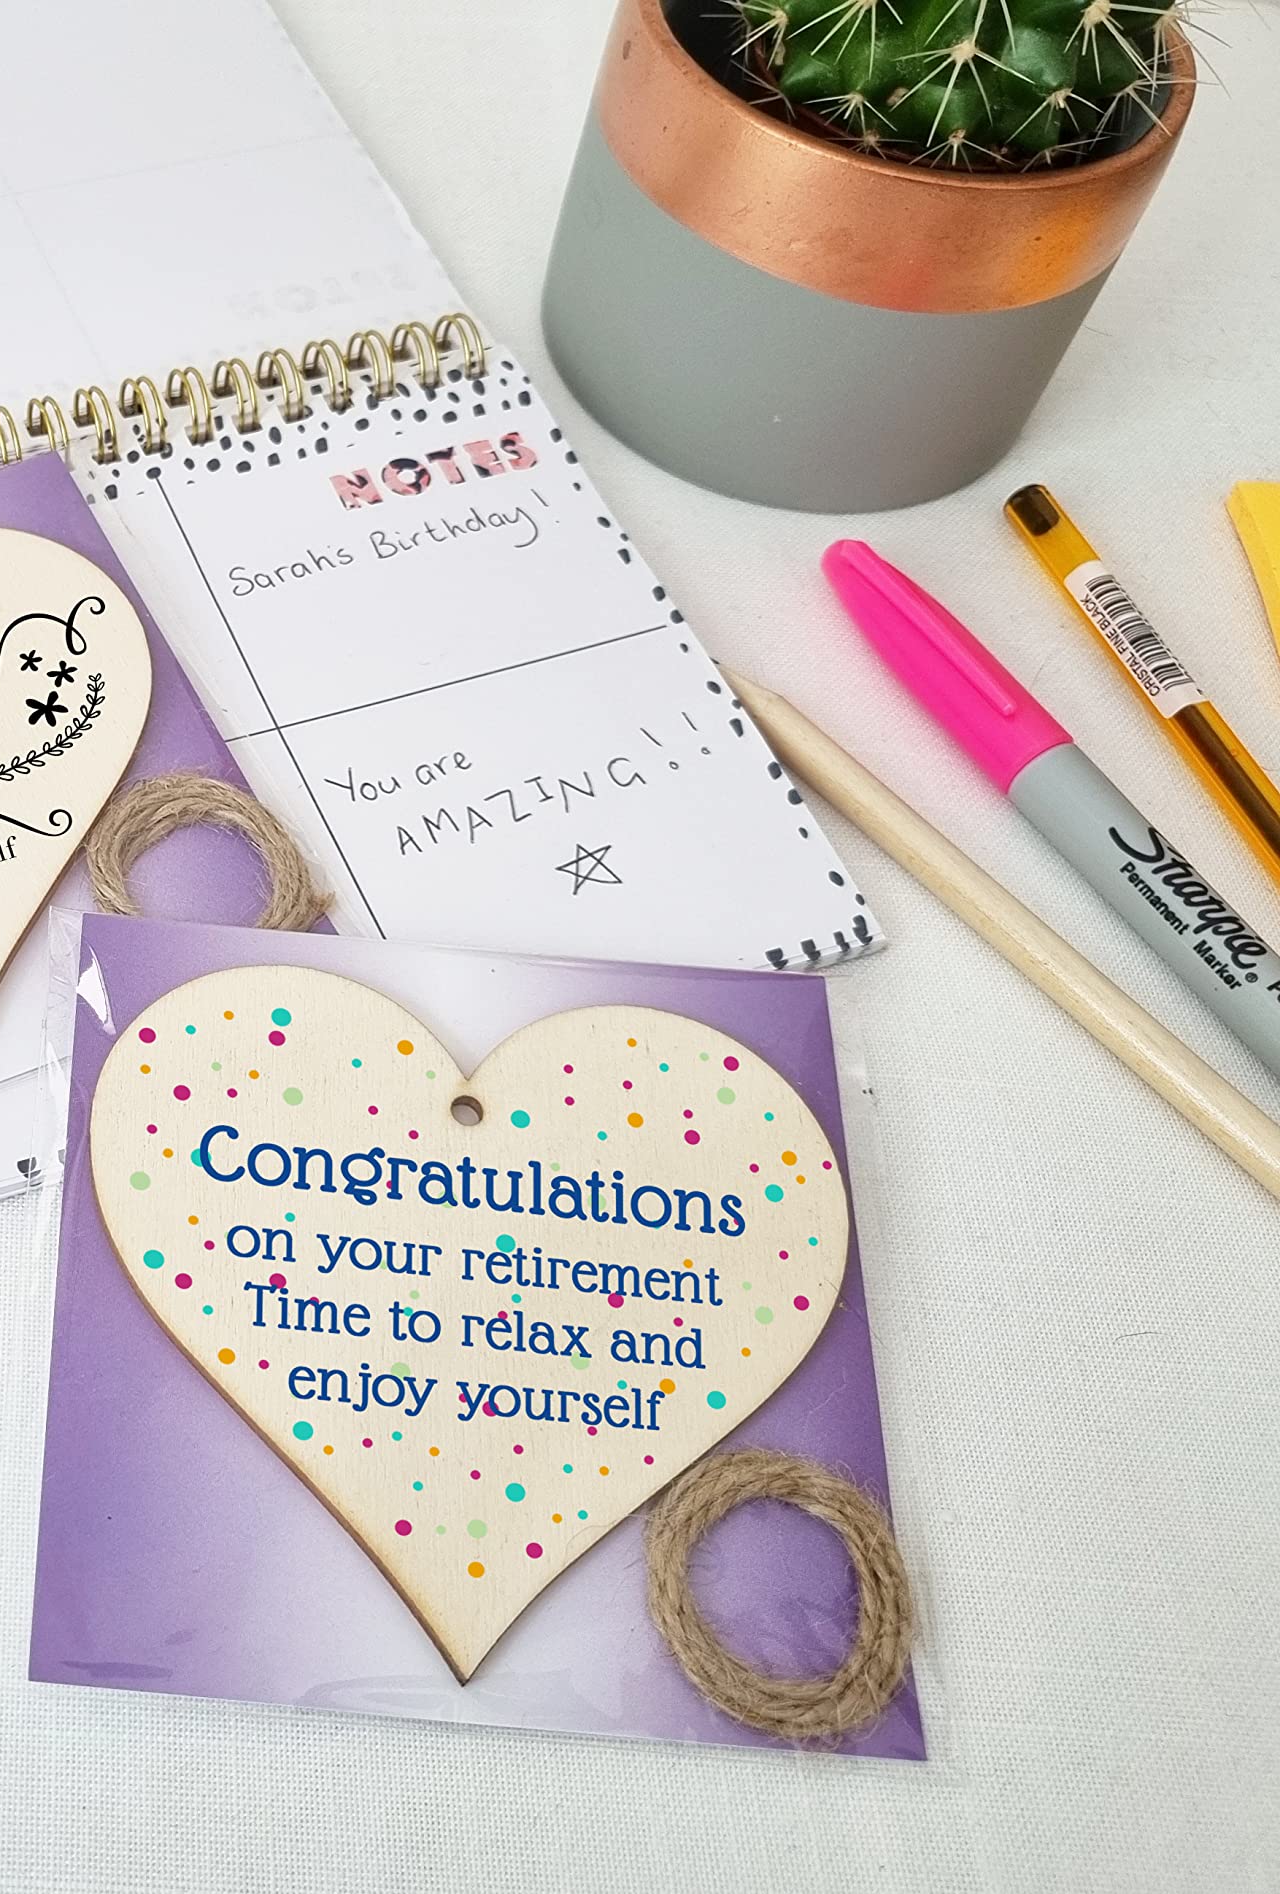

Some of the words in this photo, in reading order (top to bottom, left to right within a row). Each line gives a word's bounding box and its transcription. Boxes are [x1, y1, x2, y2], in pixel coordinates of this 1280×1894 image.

[329, 432, 538, 510] NOTES
[228, 544, 355, 597] Sarah's
[1080, 593, 1112, 632] BLACK
[1105, 628, 1127, 655] FINE
[1124, 655, 1161, 697] CRISTAL
[324, 765, 400, 802] You
[414, 750, 473, 787] are
[1108, 827, 1268, 970] Sharpie
[1119, 861, 1190, 936] Permanent
[1193, 939, 1243, 990] Marker
[198, 1124, 746, 1238] Congratulations
[226, 1224, 295, 1263] on
[316, 1230, 442, 1275] your
[461, 1246, 724, 1306] retirement
[244, 1280, 371, 1339] Time
[389, 1296, 442, 1343] to
[461, 1310, 592, 1359] relax
[609, 1326, 706, 1369] and
[288, 1363, 438, 1417] enjoy
[456, 1380, 665, 1431] yourself
